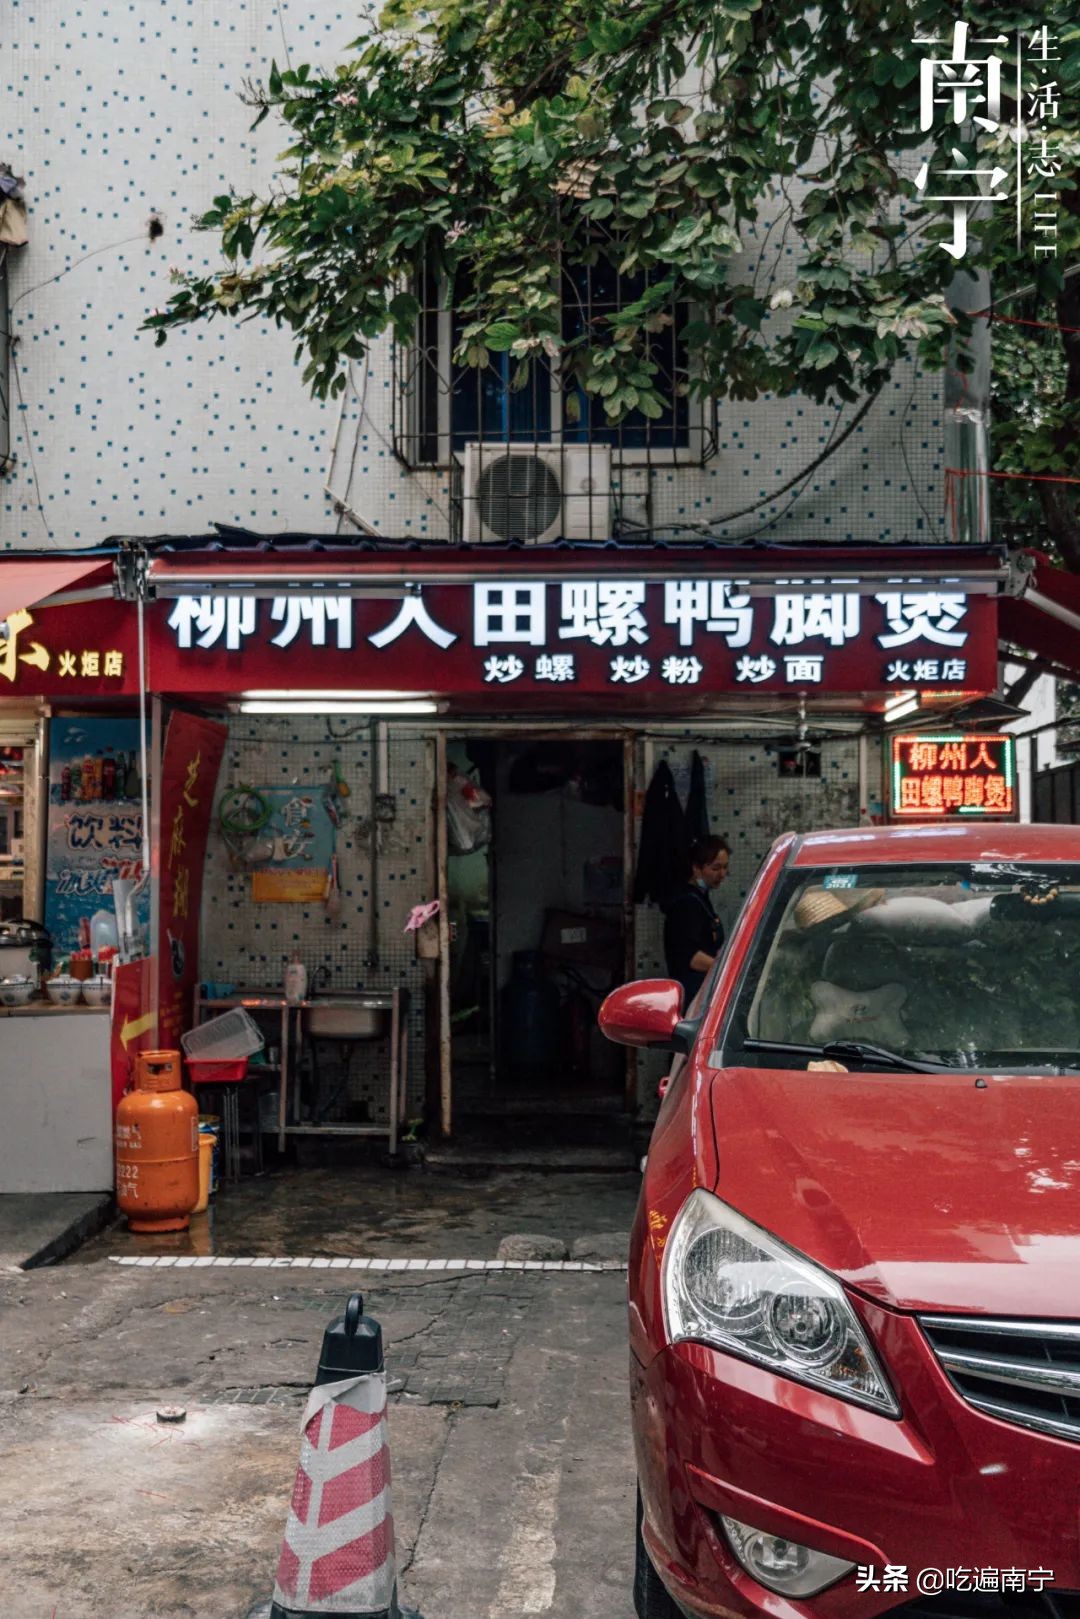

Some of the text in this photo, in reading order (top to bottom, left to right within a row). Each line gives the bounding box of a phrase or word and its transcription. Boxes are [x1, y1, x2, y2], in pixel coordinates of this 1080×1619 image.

[58, 649, 123, 677] 火炬店
[484, 654, 824, 684] 炒螺 炒粉 炒面
[886, 659, 967, 682] 火炬店
[908, 742, 998, 771] 柳州人
